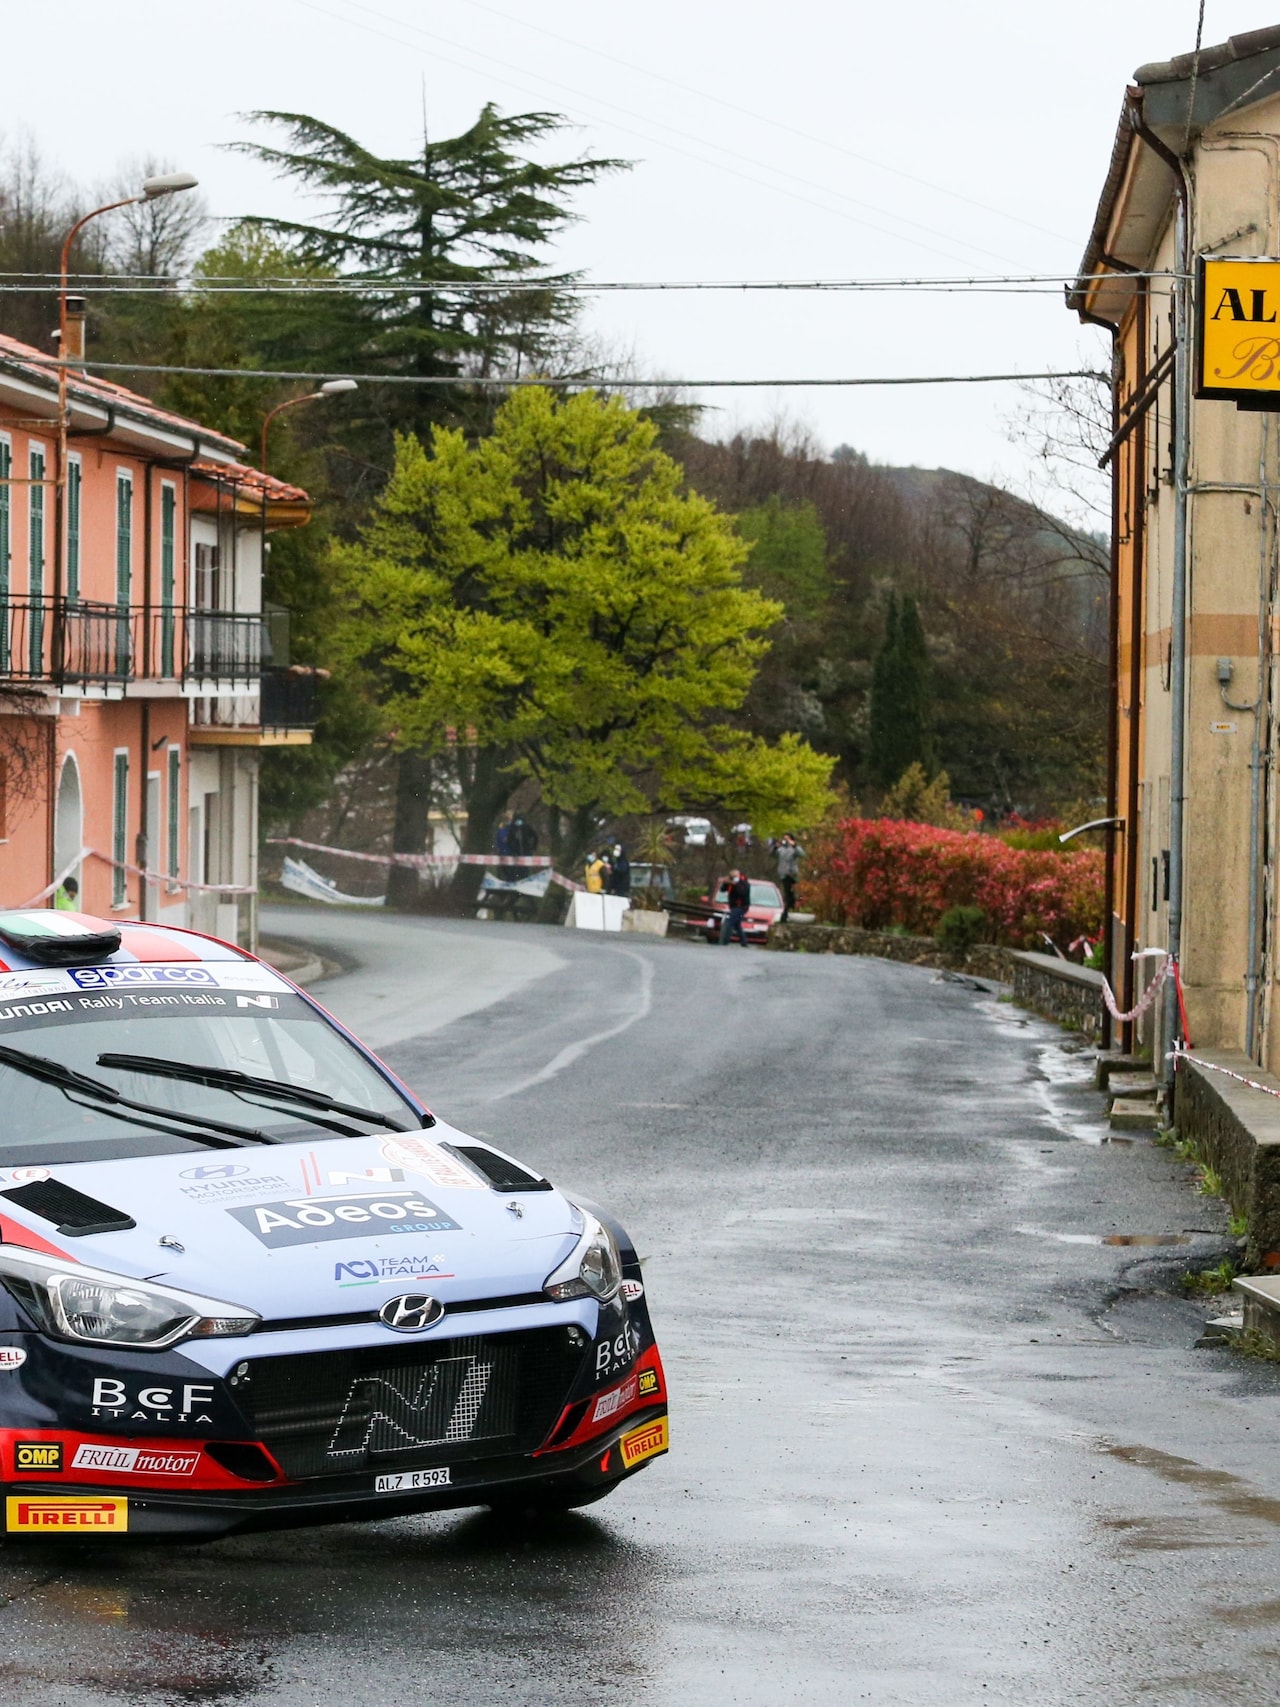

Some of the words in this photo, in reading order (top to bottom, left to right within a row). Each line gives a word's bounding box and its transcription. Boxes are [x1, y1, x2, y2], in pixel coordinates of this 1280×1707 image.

[1210, 288, 1280, 323] AL
[1214, 336, 1280, 381] B
[74, 966, 211, 988] sparco
[79, 996, 123, 1012] Rally
[124, 993, 176, 1006] Team
[179, 993, 226, 1006] Italia
[179, 1176, 286, 1193] HYUNDAI
[189, 1182, 292, 1200] MOTORSPORT
[390, 1222, 452, 1233] GROUP
[379, 1256, 428, 1266] TEAM
[381, 1264, 440, 1276] ITALIA
[621, 1283, 641, 1294] ELL
[595, 1348, 636, 1381] ITALIA
[639, 1374, 656, 1391] OMP
[91, 1407, 213, 1423] ITALIA
[624, 1424, 663, 1460] PIRELLI
[18, 1448, 59, 1465] OMP
[18, 1502, 117, 1525] PIRELLI
